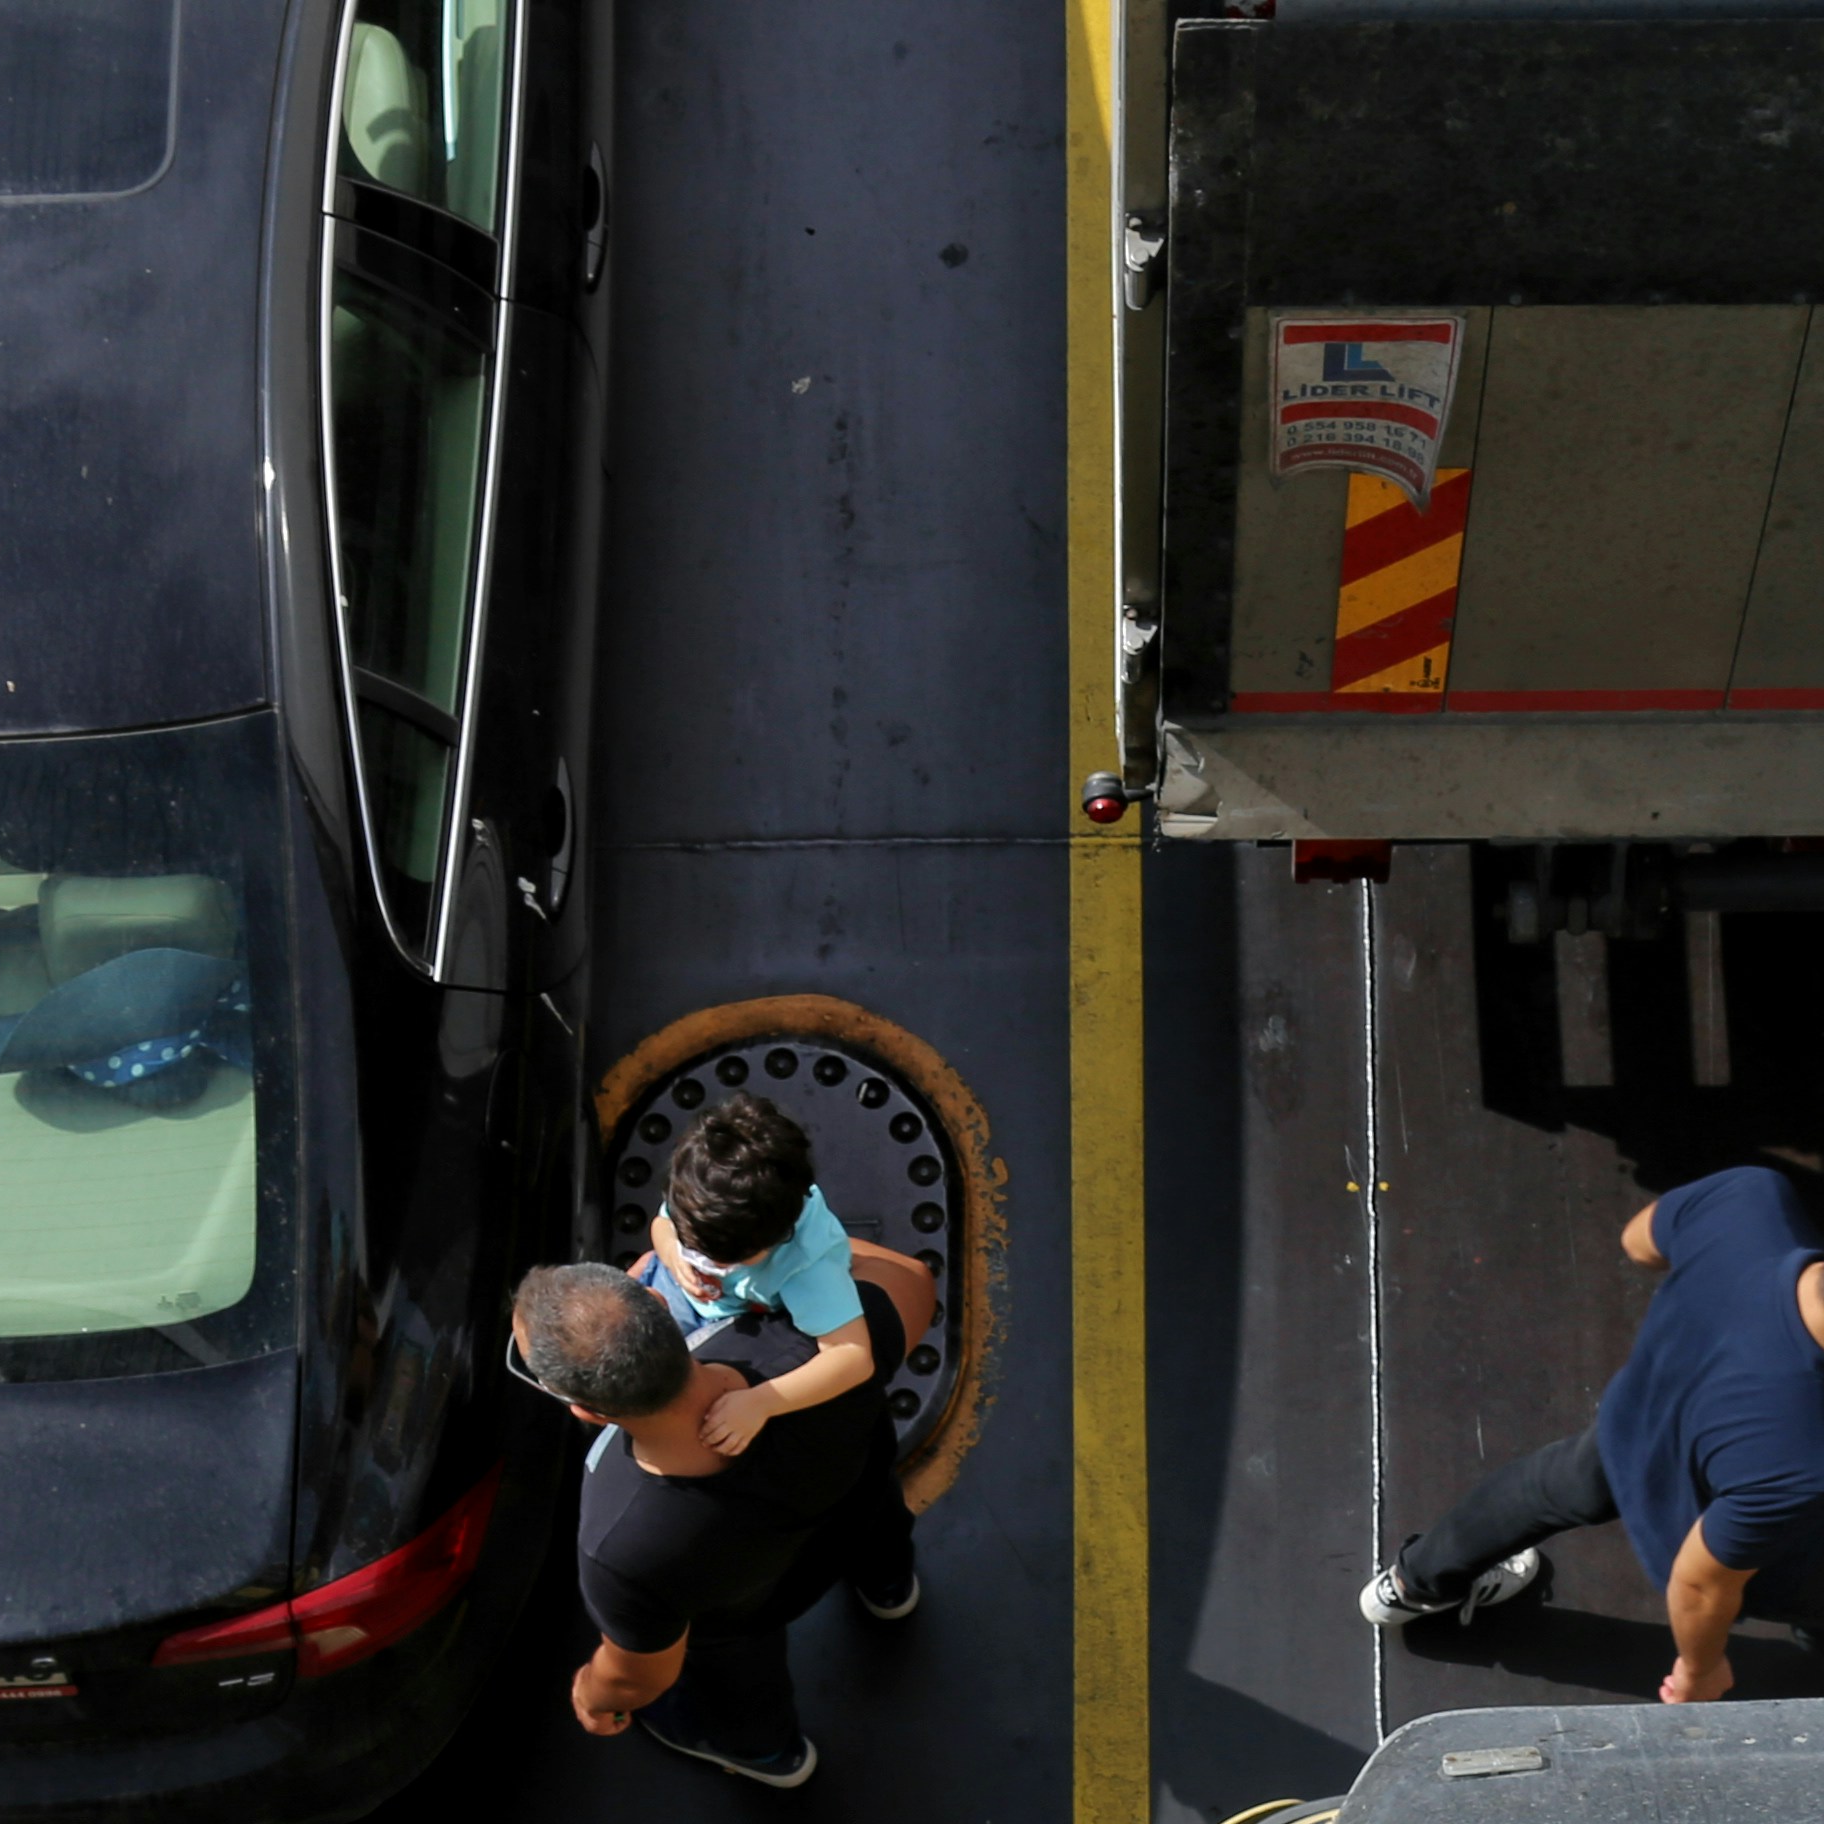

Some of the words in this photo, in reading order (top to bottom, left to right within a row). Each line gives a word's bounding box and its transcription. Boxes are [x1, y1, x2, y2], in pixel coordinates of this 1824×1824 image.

[1283, 384, 1369, 401] LİDER
[1380, 384, 1441, 408] LİFT
[1343, 421, 1376, 431] 958
